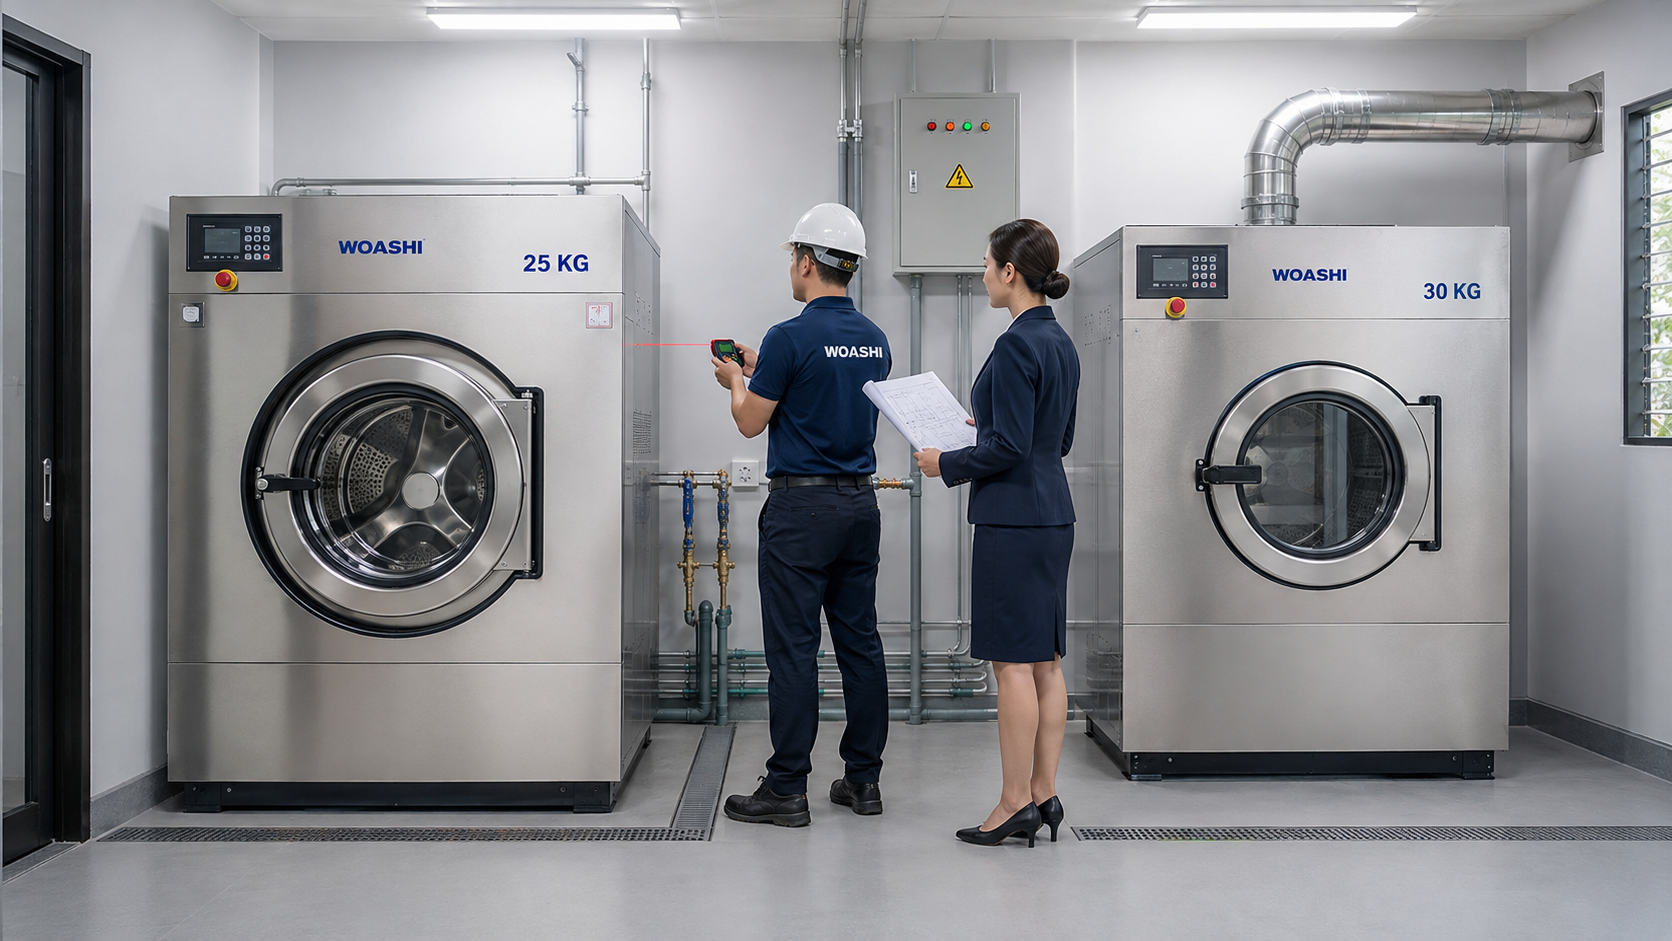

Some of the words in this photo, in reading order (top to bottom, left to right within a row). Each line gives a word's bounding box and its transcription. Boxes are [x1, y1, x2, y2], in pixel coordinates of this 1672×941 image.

[339, 240, 423, 255] WOASHI
[523, 254, 551, 273] 25
[557, 254, 589, 273] KG
[1272, 268, 1348, 282] WOASHI
[1423, 282, 1448, 300] 30
[1453, 282, 1481, 300] KG
[824, 345, 883, 359] WOASHI
